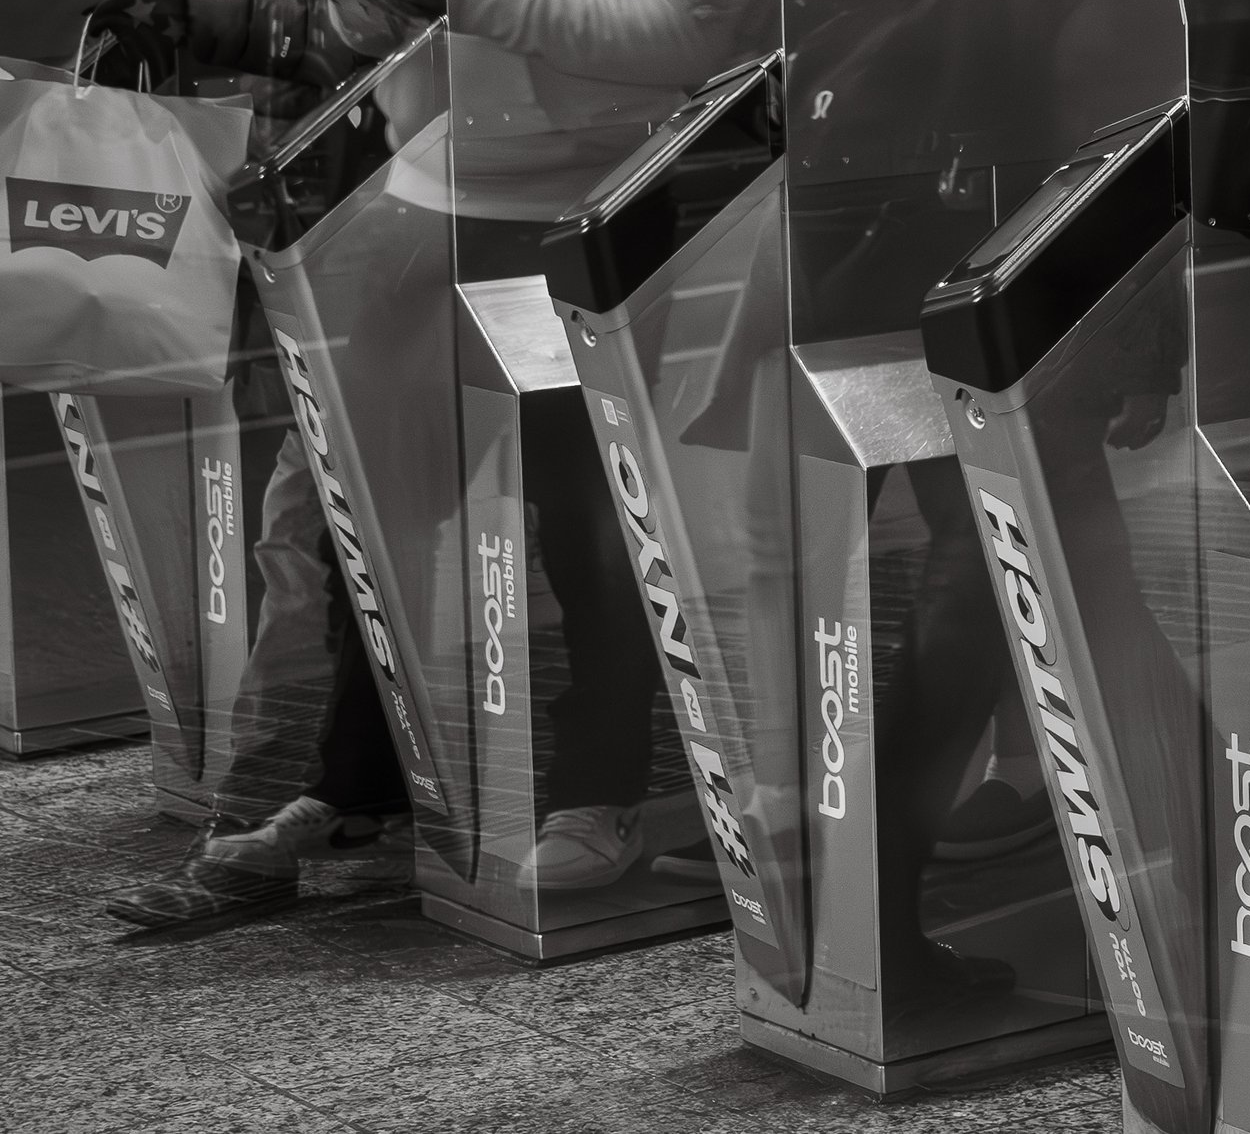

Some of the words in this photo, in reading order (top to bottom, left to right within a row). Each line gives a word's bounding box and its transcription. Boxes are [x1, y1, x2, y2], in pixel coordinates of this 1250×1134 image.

[201, 457, 227, 624] boost
[220, 462, 235, 536] mobile
[275, 327, 399, 681] SWITCH
[609, 441, 702, 681] NYC
[477, 531, 507, 716] boost
[502, 537, 516, 619] mobile
[814, 616, 847, 820] boost
[844, 625, 860, 714] mobile
[979, 488, 1122, 922] SWITCH
[690, 739, 757, 878] #1
[1108, 932, 1128, 981] YOU
[1120, 938, 1147, 1017] GOTTA
[1127, 1026, 1168, 1059] boost
